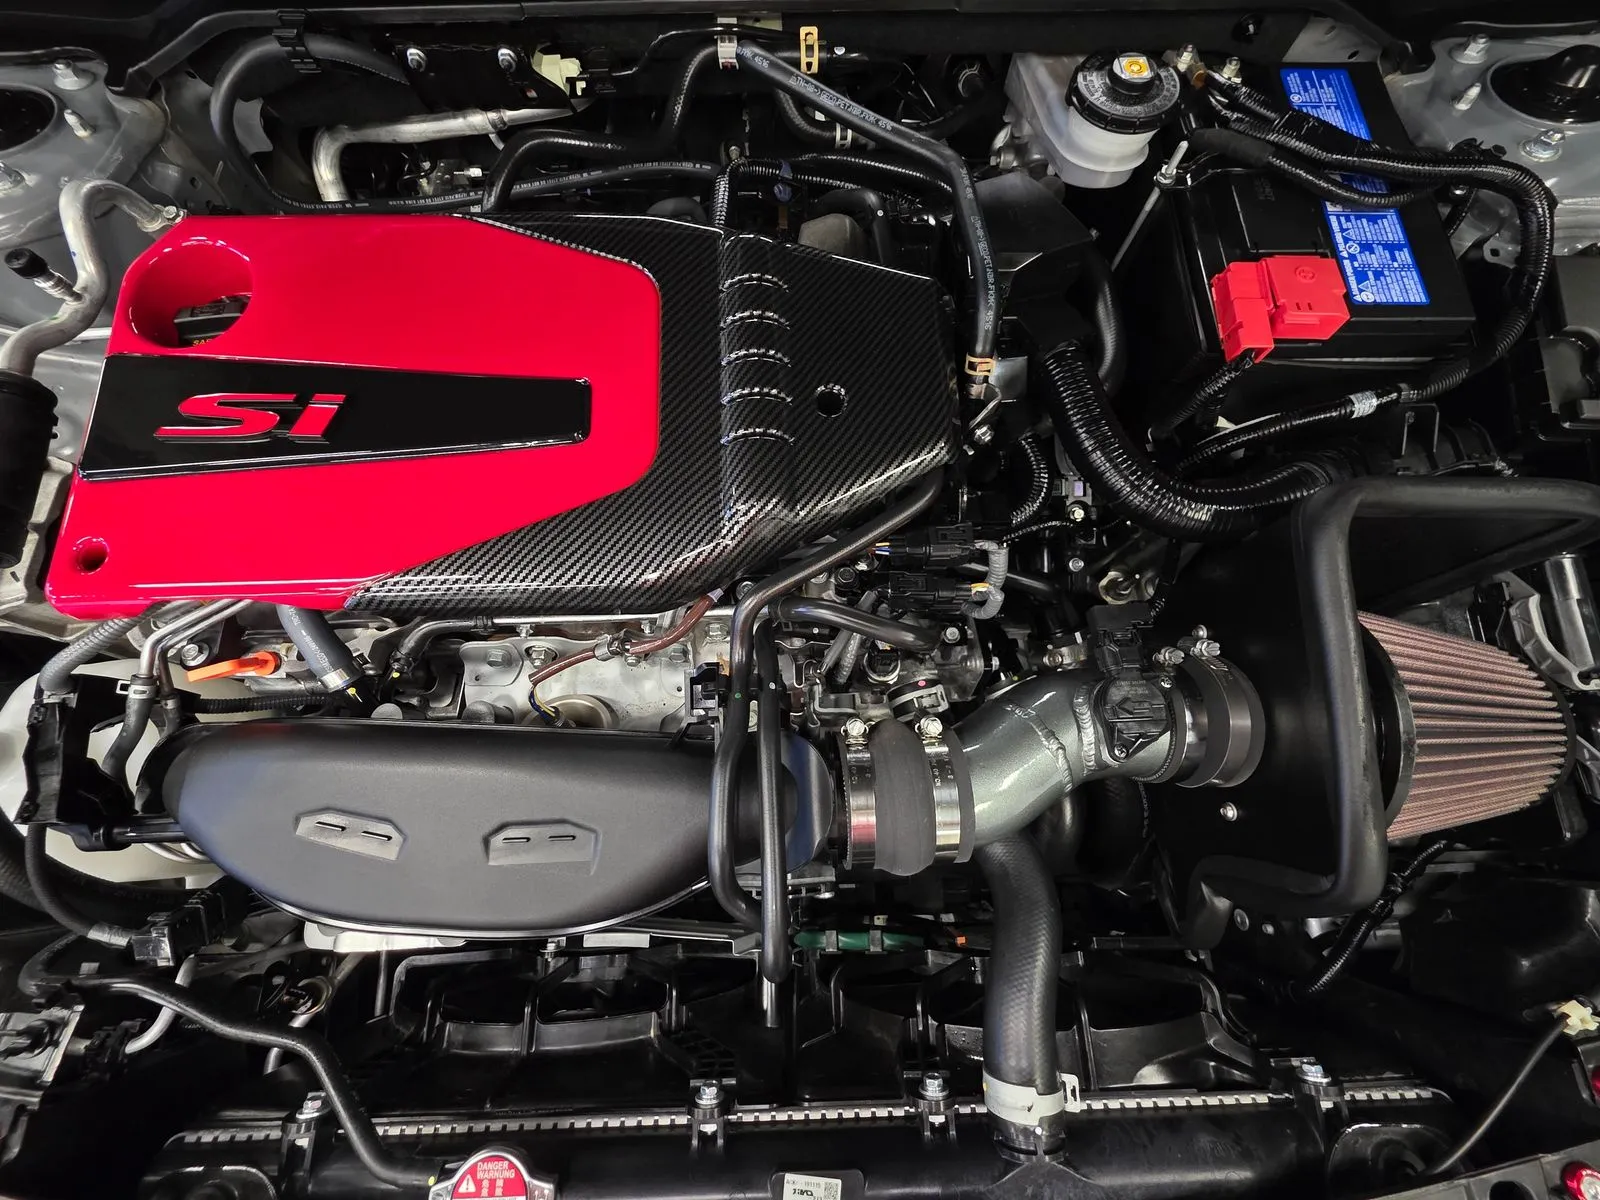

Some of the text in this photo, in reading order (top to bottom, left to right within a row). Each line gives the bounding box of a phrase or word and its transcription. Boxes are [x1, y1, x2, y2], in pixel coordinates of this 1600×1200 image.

[153, 392, 347, 441] Si
[477, 1161, 509, 1171] DANGER
[476, 1169, 516, 1180] WARNUNG
